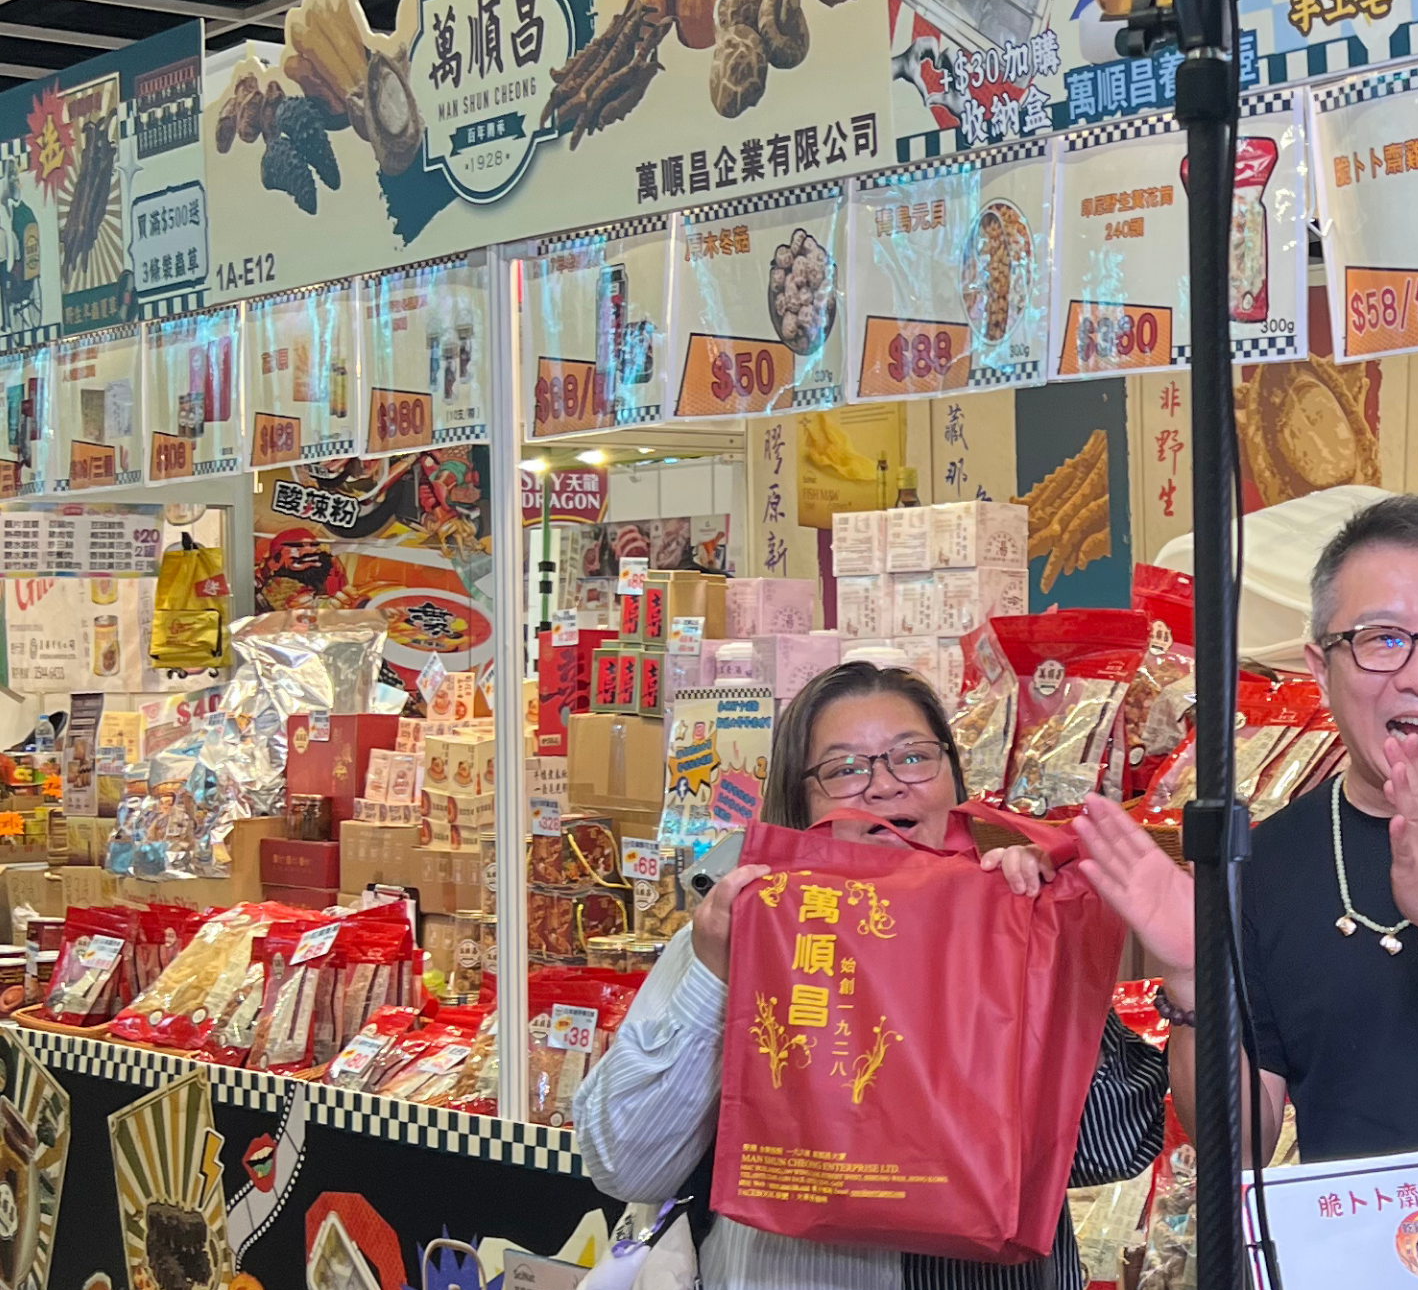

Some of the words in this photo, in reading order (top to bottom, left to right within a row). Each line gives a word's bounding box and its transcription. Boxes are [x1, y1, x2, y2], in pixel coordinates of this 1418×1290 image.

[940, 29, 1061, 96] +$30加購
[1066, 35, 1257, 121] 萬順昌養壺
[438, 101, 458, 123] MAN
[463, 93, 490, 116] SHUN
[493, 77, 537, 106] CHEONG
[961, 83, 1053, 144] 收納盒
[635, 112, 879, 204] 萬順昌企業有限公司
[215, 253, 276, 293] 1A-E12
[1260, 318, 1295, 335] 300g
[711, 349, 775, 402] $50
[887, 330, 953, 382] $88
[277, 484, 358, 526] 酸辣粉
[134, 528, 160, 544] $20
[788, 884, 843, 1028] 萬順昌
[829, 956, 858, 1078] 始創一九二八
[822, 1162, 879, 1174] ENTERPRISE
